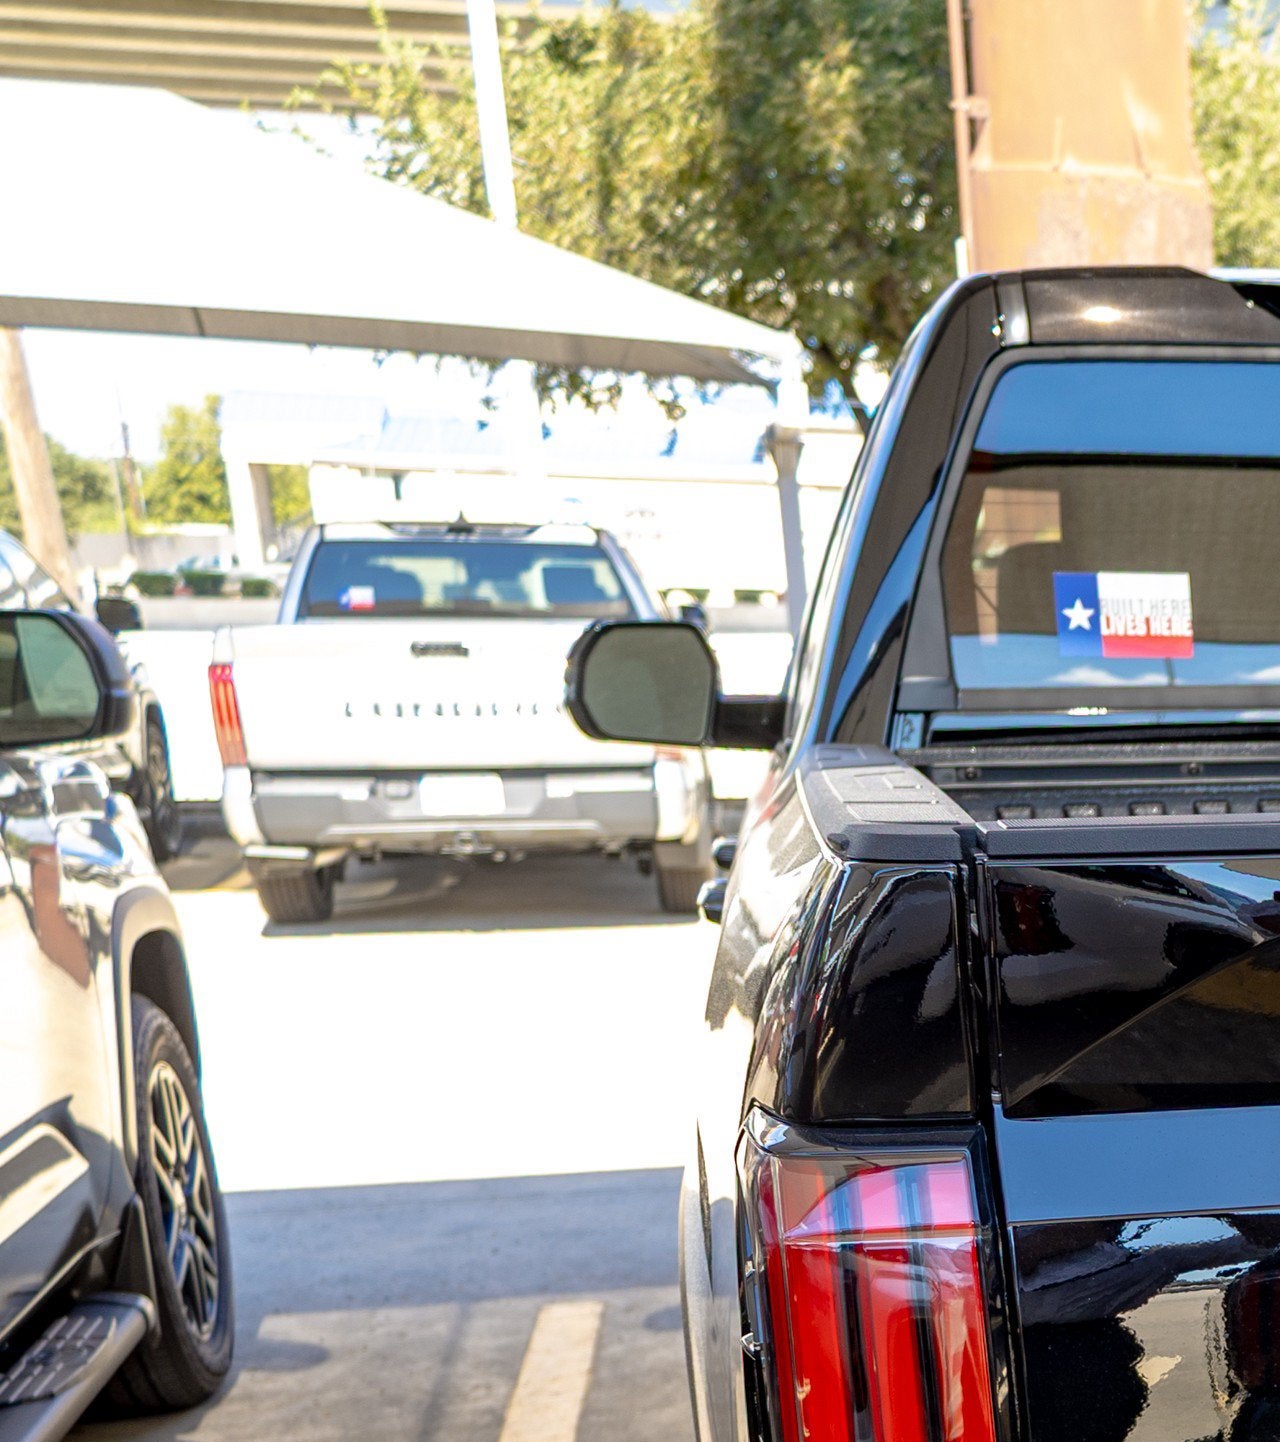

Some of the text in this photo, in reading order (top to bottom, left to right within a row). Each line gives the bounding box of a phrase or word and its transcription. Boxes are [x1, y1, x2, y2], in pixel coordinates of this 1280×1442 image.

[1150, 597, 1192, 617] HERE
[1102, 615, 1194, 636] LIVES HERE
